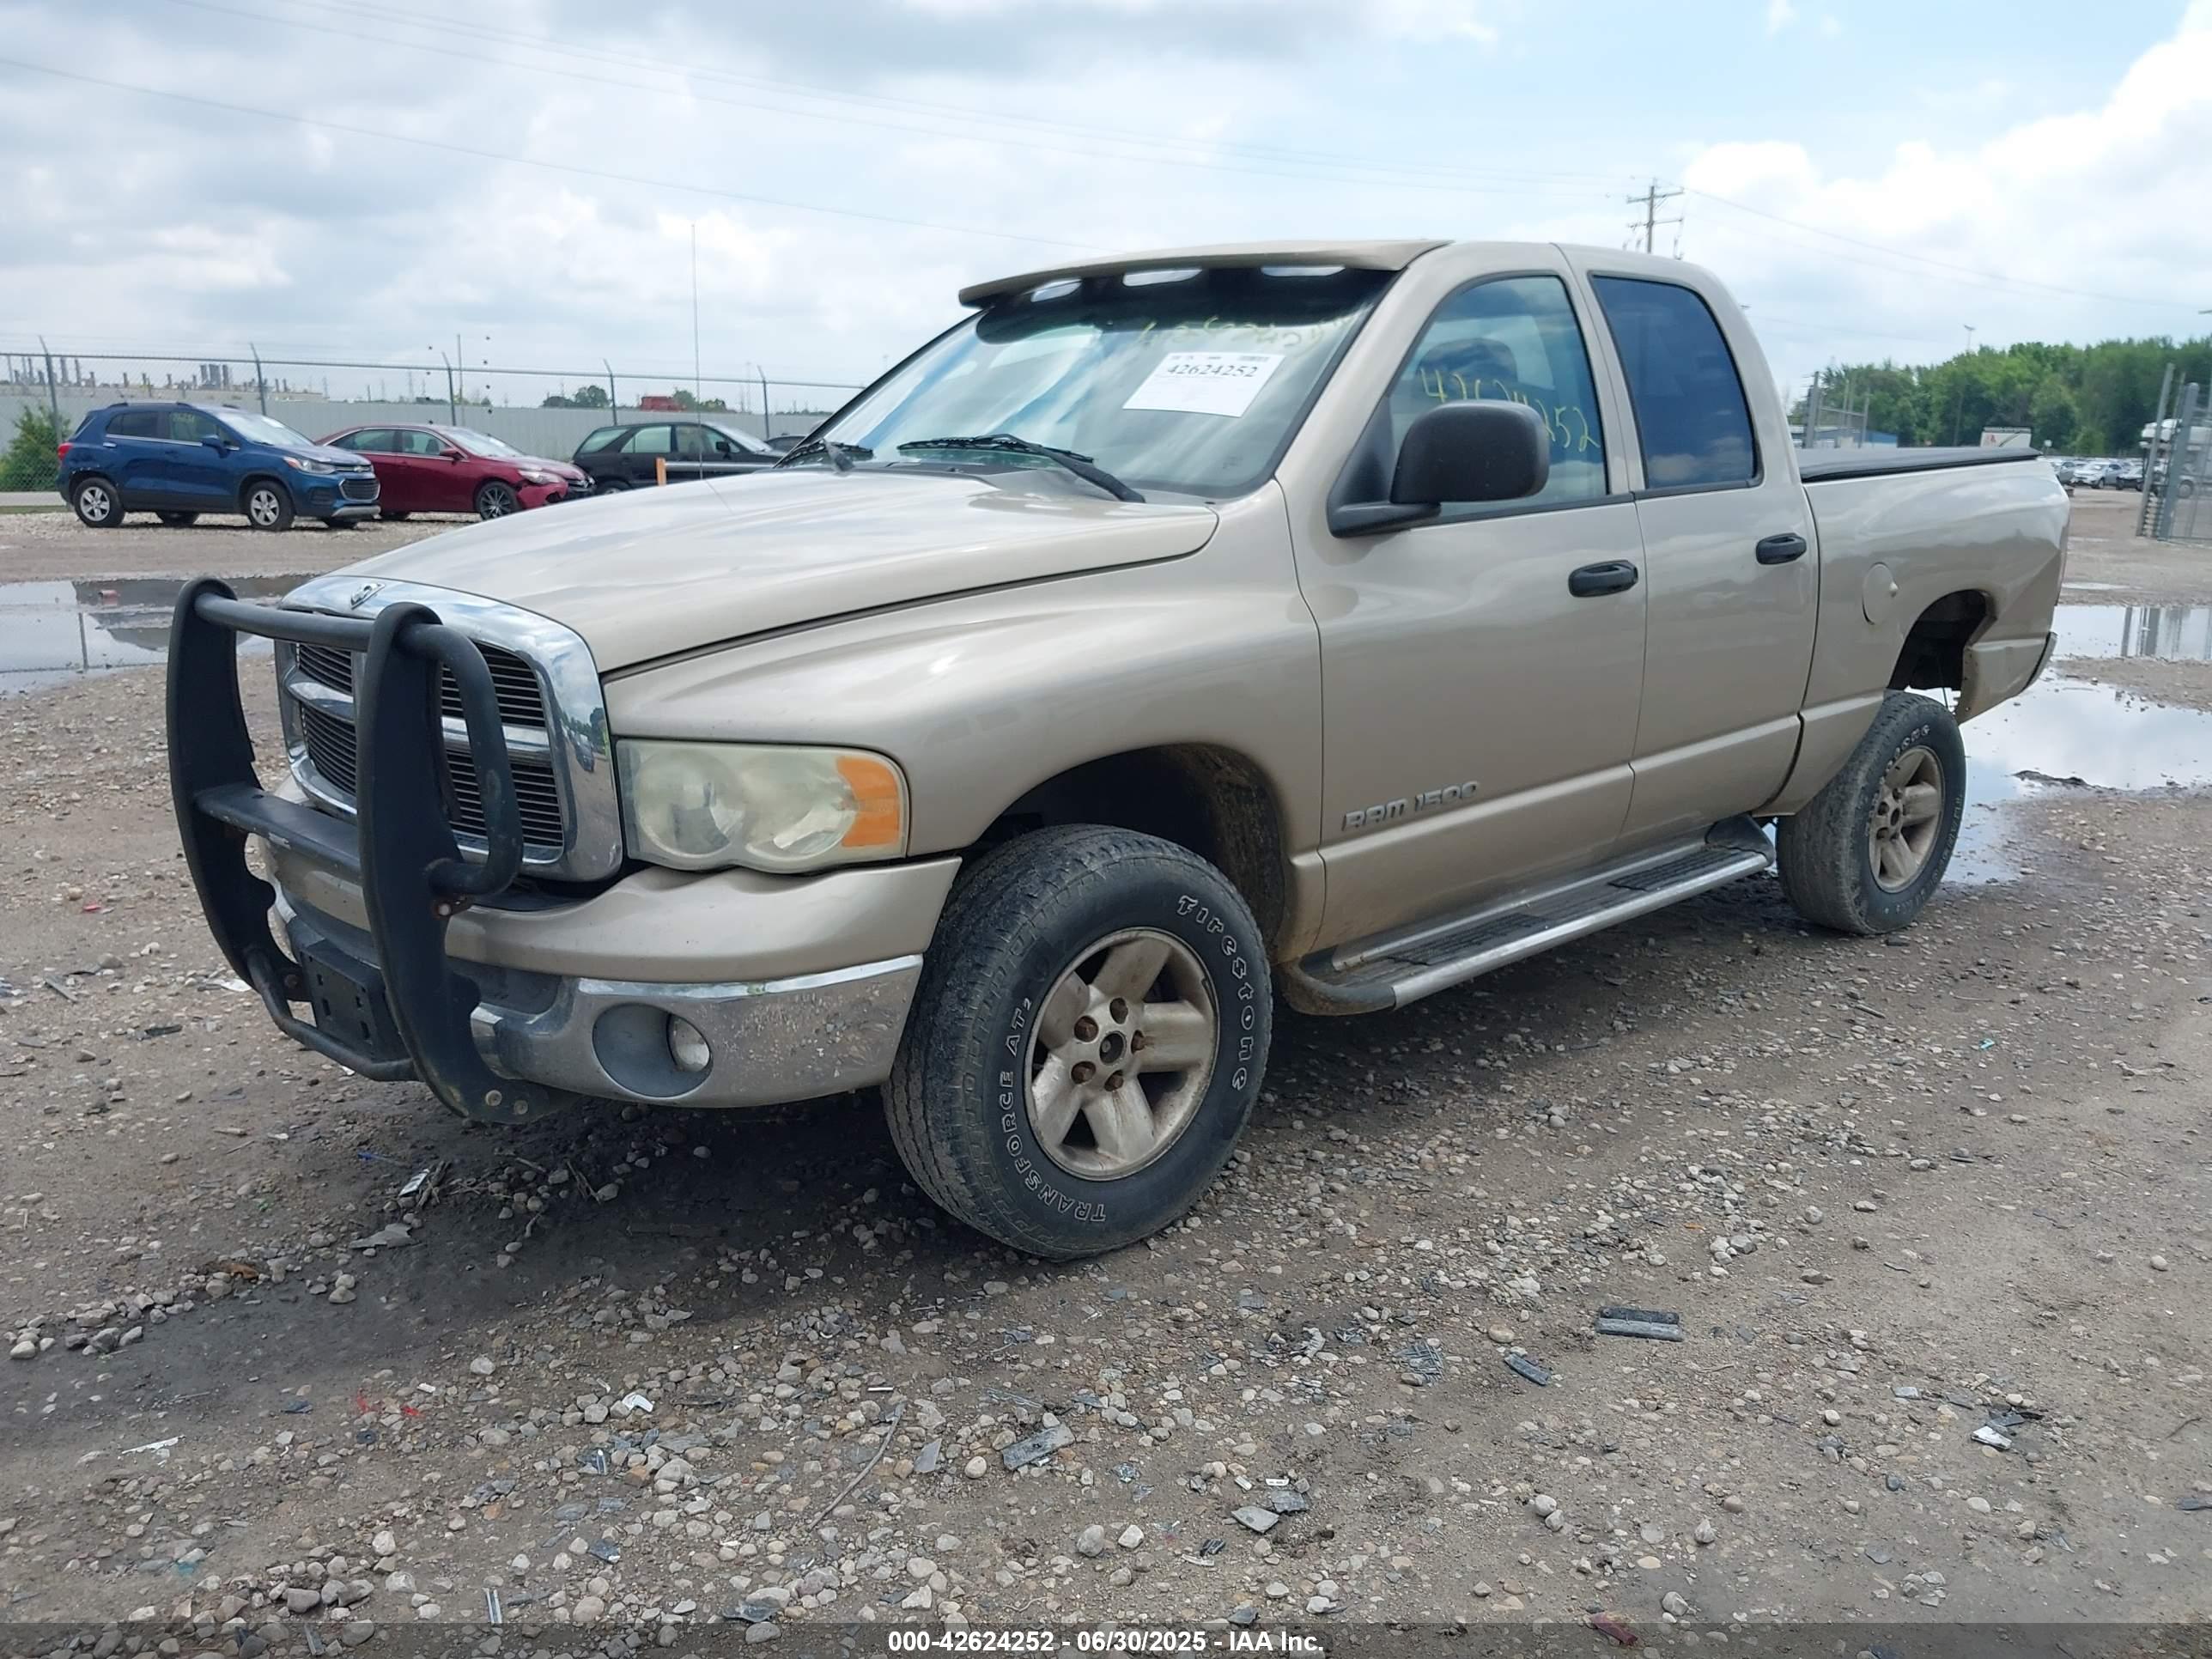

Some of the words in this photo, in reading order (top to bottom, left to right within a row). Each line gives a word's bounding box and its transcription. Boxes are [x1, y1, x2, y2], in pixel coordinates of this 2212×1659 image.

[1168, 363, 1259, 378] 42624252
[1341, 798, 1408, 831] RAM
[1415, 781, 1479, 811] 1500
[1177, 895, 1255, 1091] Firestone
[999, 1071, 1108, 1222] TRANSFORCE
